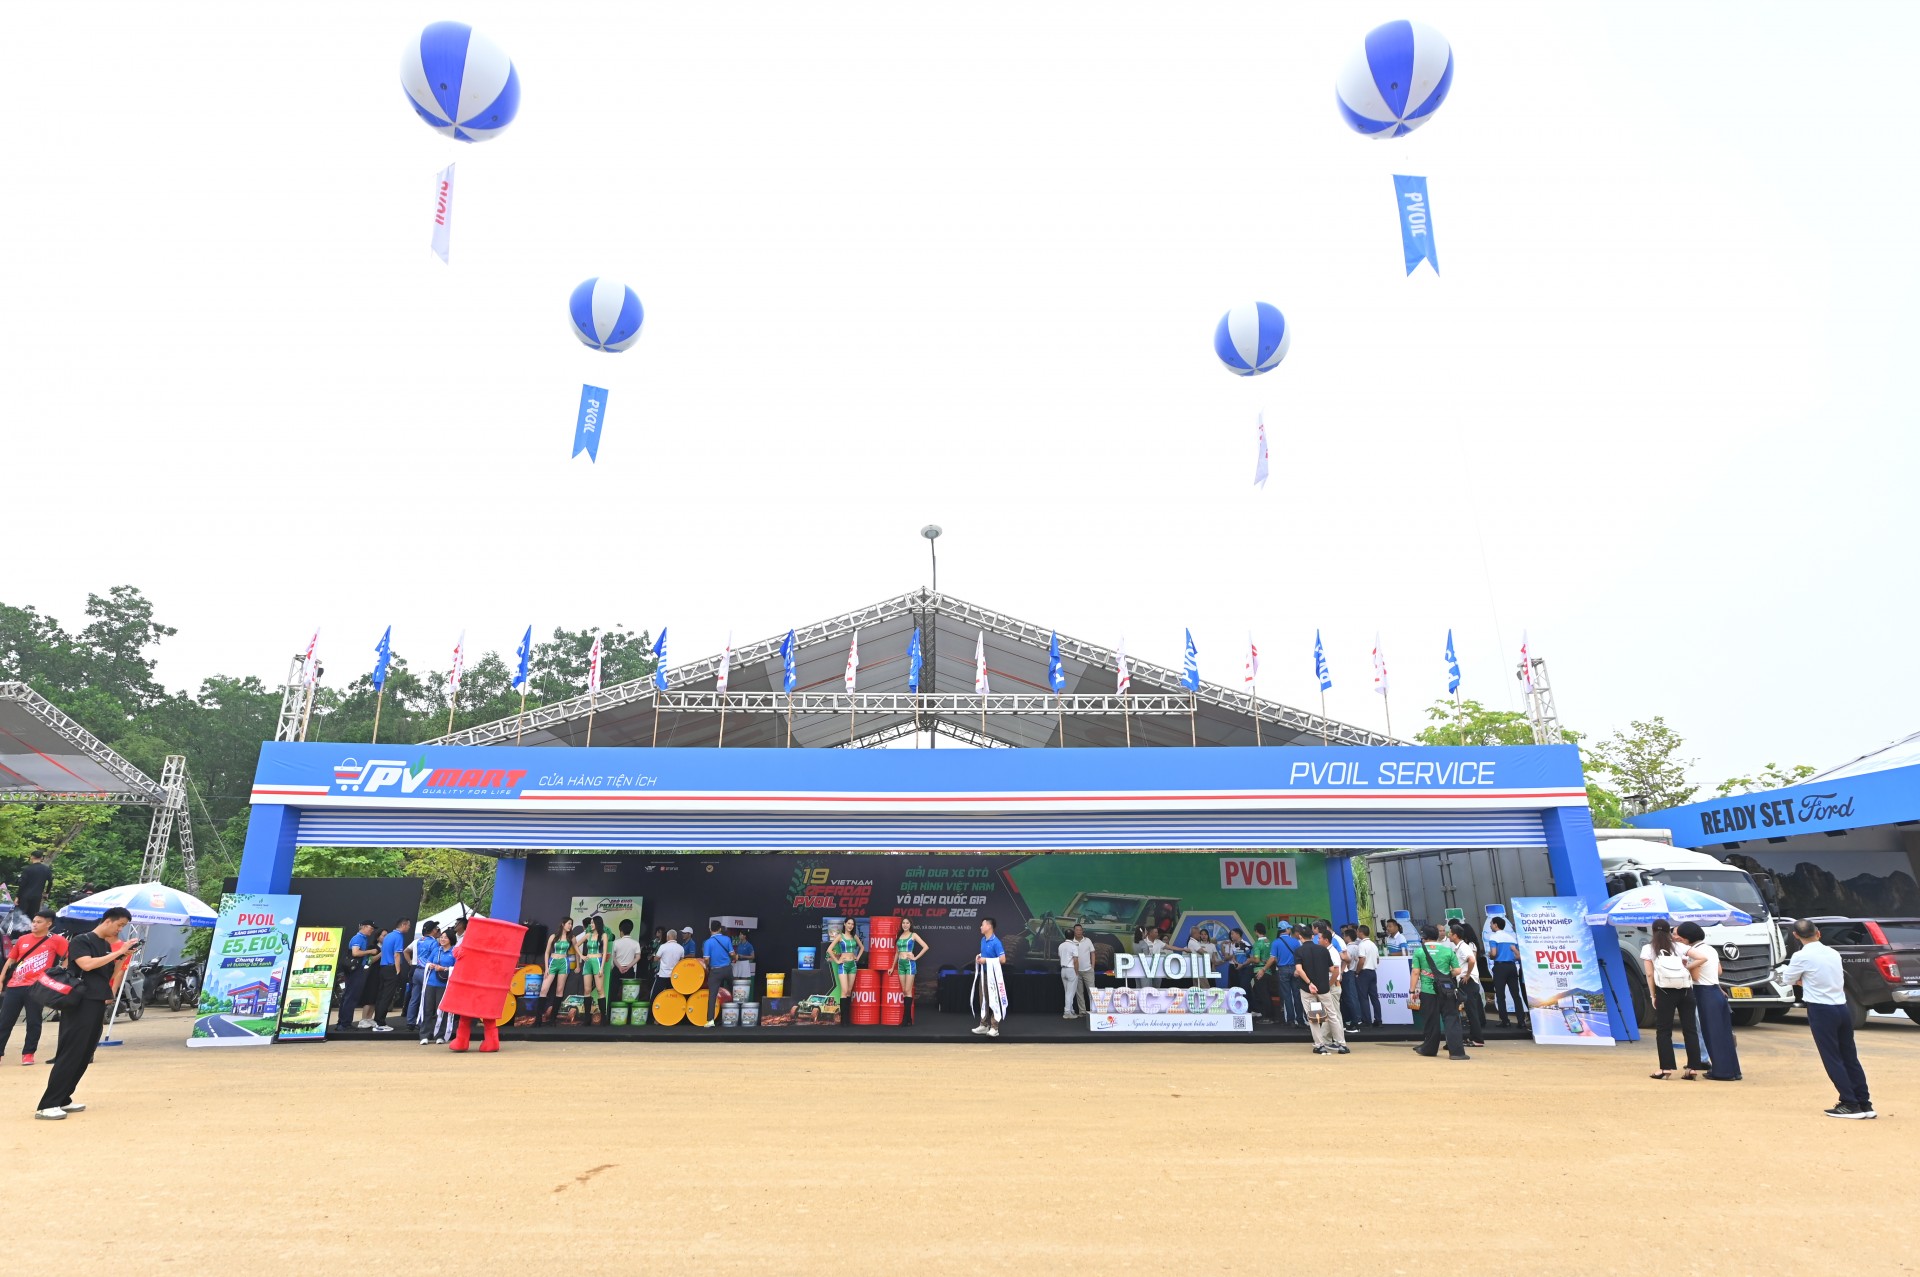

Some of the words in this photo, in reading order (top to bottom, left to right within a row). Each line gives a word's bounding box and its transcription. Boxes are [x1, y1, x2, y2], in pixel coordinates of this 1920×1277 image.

[1404, 192, 1426, 238] PVOIL
[584, 399, 600, 433] PVOIL
[1290, 762, 1368, 784] PVOIL
[1378, 762, 1496, 784] SERVICE
[538, 773, 564, 786] CỬA
[567, 774, 602, 786] HÀNG
[606, 774, 633, 788] TIỆN
[635, 774, 658, 786] ÍCH
[1700, 804, 1756, 835] READY
[1760, 798, 1795, 827] SET
[1798, 792, 1854, 822] Ford
[803, 868, 830, 884] 19
[952, 869, 966, 877] XE
[1224, 861, 1292, 886] PVOIL
[806, 886, 872, 896] OFFROAD
[946, 881, 970, 892] VIỆT
[972, 882, 995, 891] NAM
[793, 896, 836, 908] PVOIL
[838, 897, 869, 908] CUP
[896, 894, 912, 904] VÔ
[913, 894, 937, 906] ĐỊCH
[938, 893, 967, 905] QUỐC
[969, 896, 987, 904] GIA
[893, 908, 922, 917] PVOIL
[926, 908, 948, 917] CUP
[949, 908, 978, 917] 2026
[238, 914, 275, 926] PVOIL
[305, 932, 330, 941] PVOIL
[870, 937, 895, 949] PVOIL
[1535, 951, 1581, 963] PVOIL
[1114, 952, 1222, 979] PVOIL
[852, 991, 876, 1003] PVOIL
[887, 992, 904, 1003] PVO
